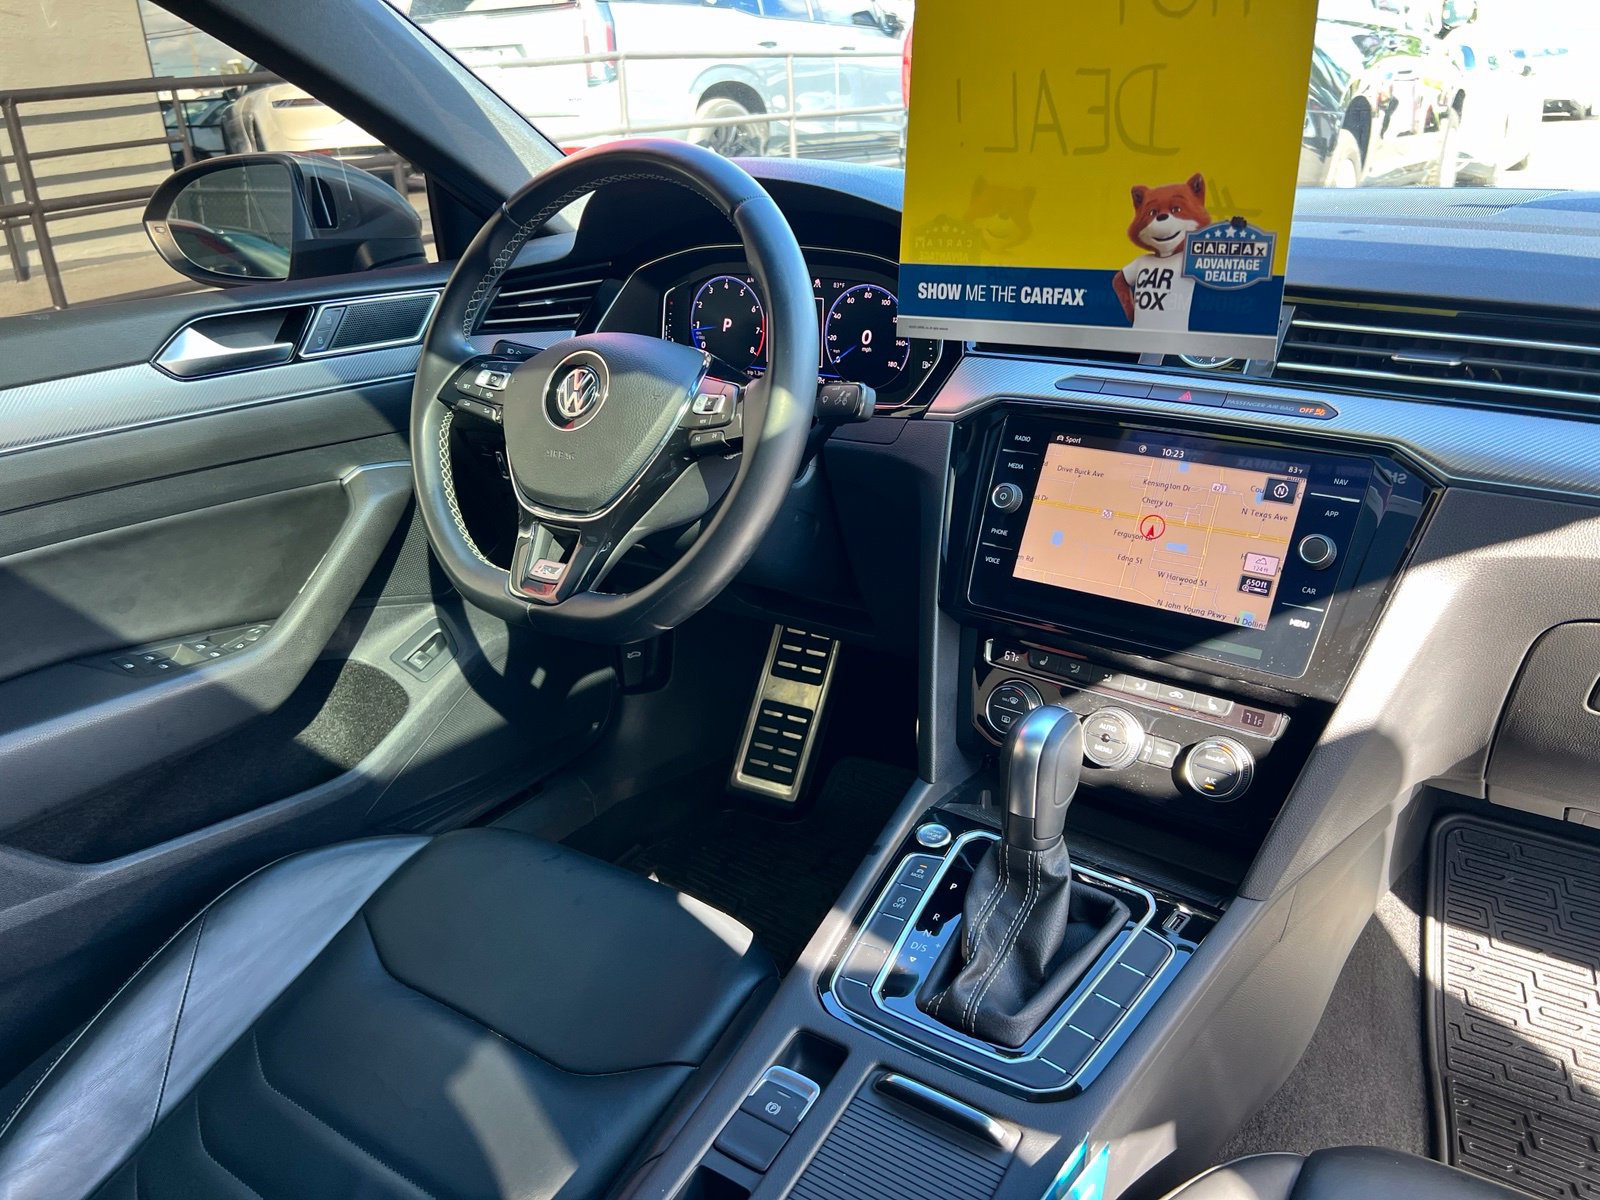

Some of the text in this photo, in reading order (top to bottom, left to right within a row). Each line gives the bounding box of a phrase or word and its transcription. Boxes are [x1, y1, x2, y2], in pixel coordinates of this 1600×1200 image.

[1192, 242, 1266, 257] CARFAX
[1194, 257, 1261, 271] ADVANTAGE
[1136, 266, 1173, 291] CAR
[1204, 270, 1248, 283] DEALER
[708, 286, 714, 294] 3
[723, 282, 729, 290] 4
[739, 288, 745, 297] 5
[863, 291, 873, 299] 80
[917, 281, 1086, 307] SHOW ME THE CARFAX
[697, 301, 703, 309] 2
[846, 297, 855, 305] 60
[751, 305, 757, 313] 6
[722, 317, 733, 332] P
[755, 326, 761, 335] 7
[861, 329, 873, 345] 0
[700, 341, 707, 349] 0
[749, 346, 755, 354] 8
[861, 346, 873, 354] mph
[1210, 355, 1217, 363] 6
[1226, 399, 1266, 409] PASSENGER
[1298, 406, 1315, 415] OFF
[1014, 434, 1031, 443] RADIO
[1064, 435, 1082, 445] Sport
[1161, 447, 1185, 459] 10:23
[1007, 462, 1024, 470] MEDIA
[1056, 464, 1073, 474] Drive
[1091, 469, 1105, 478] Ave
[1142, 478, 1192, 493] Kensington Dr
[1333, 477, 1349, 486] NAV
[1141, 496, 1174, 510] Cherry Ln
[1241, 507, 1289, 522] N Texas Ave
[1324, 509, 1340, 518] APP
[990, 527, 1009, 537] PHONE
[1113, 529, 1144, 541] Ferguson
[984, 556, 1001, 565] VOICE
[1025, 554, 1035, 563] Rd
[1117, 553, 1143, 565] Edna St
[1157, 570, 1208, 588] W Harwood St
[1301, 586, 1317, 595] CAR
[1156, 599, 1227, 622] N John Young Pkwy
[1233, 615, 1241, 624] N
[1288, 618, 1311, 630] MENU
[1098, 722, 1118, 733] AUTO
[1204, 776, 1218, 786] A/C
[949, 882, 958, 890] P
[932, 912, 941, 922] R
[922, 928, 933, 938] N
[910, 941, 928, 953] D/S
